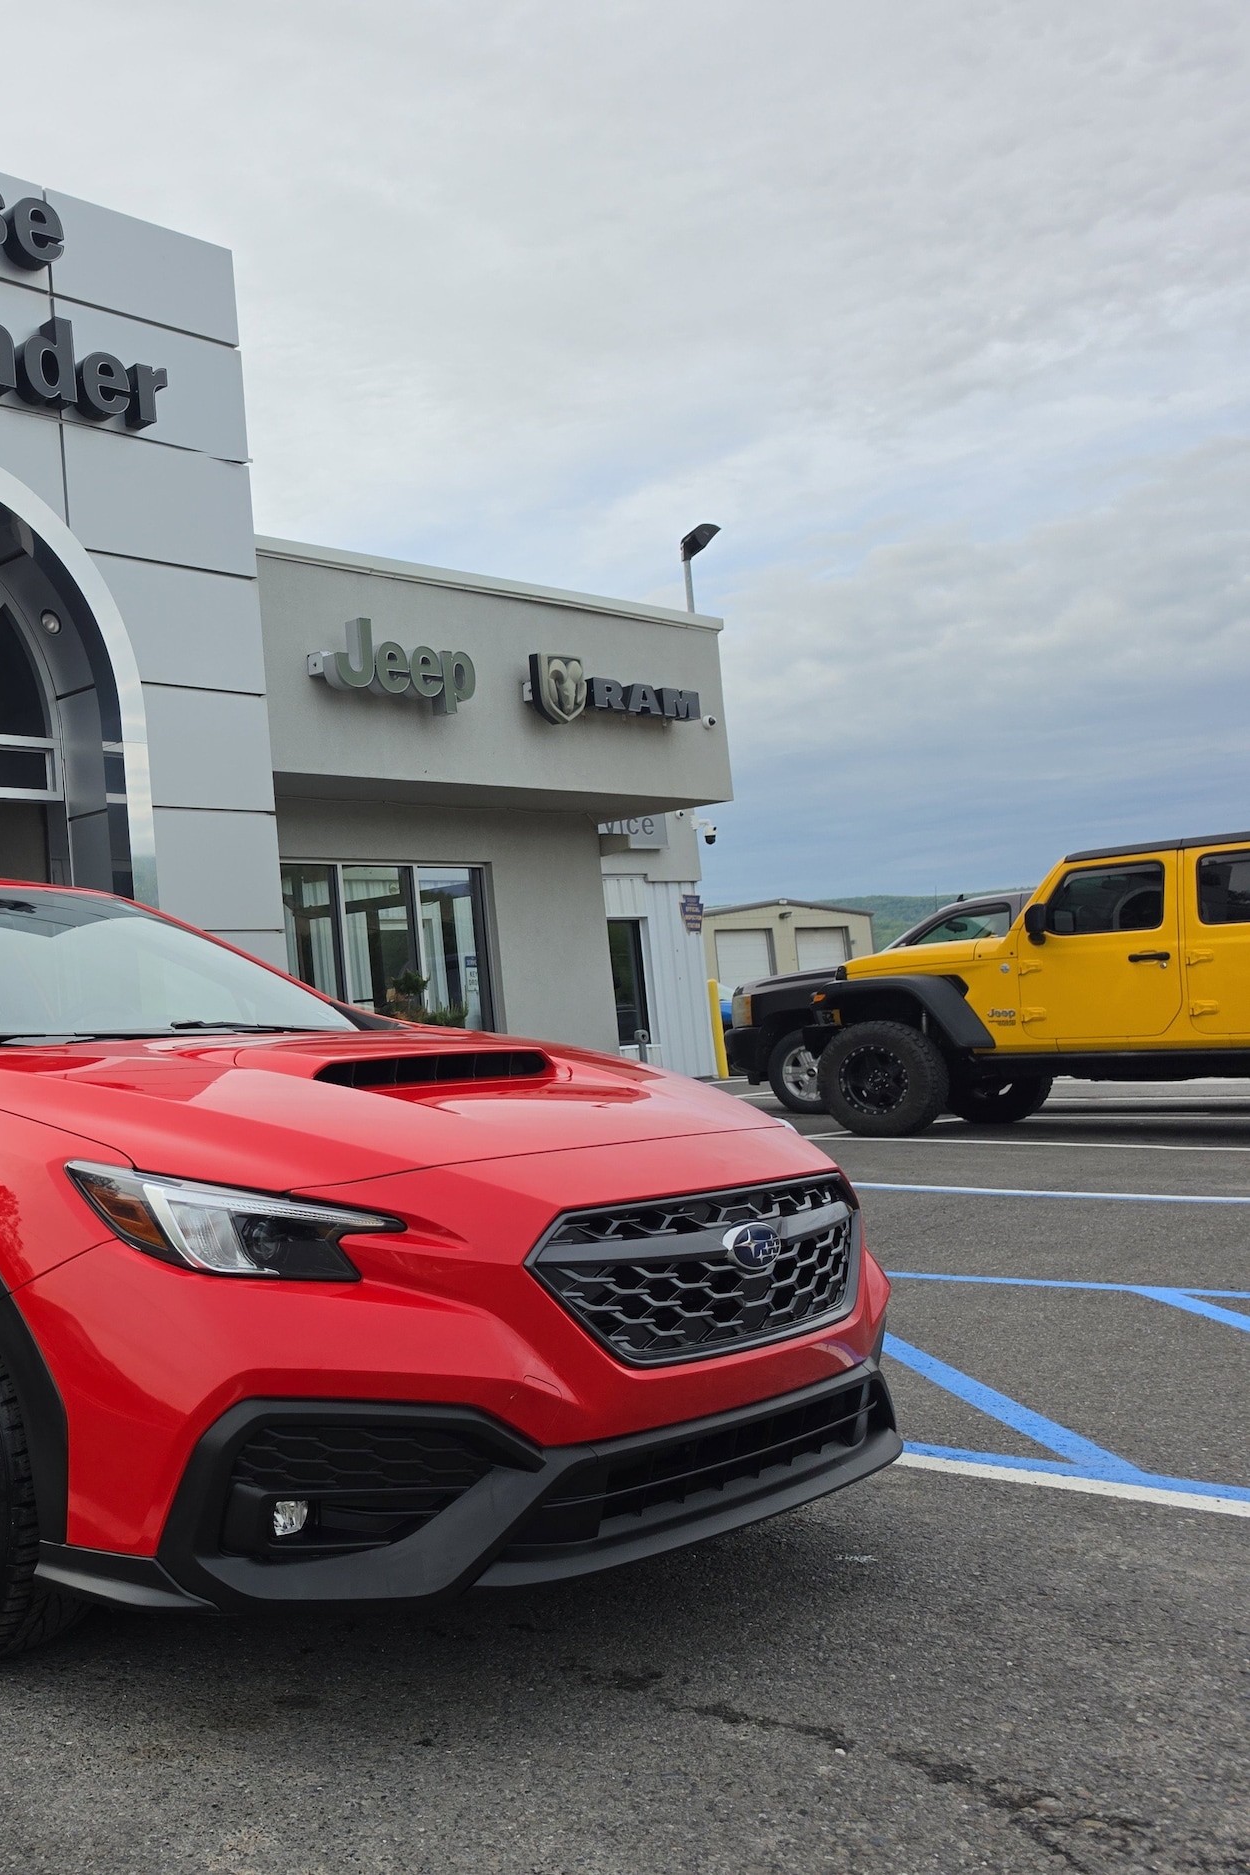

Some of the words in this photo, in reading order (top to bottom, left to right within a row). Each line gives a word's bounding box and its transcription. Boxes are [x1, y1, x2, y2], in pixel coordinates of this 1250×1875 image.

[323, 617, 476, 716] Jeep
[585, 676, 701, 721] RAM
[987, 1008, 1016, 1018] Jeep
